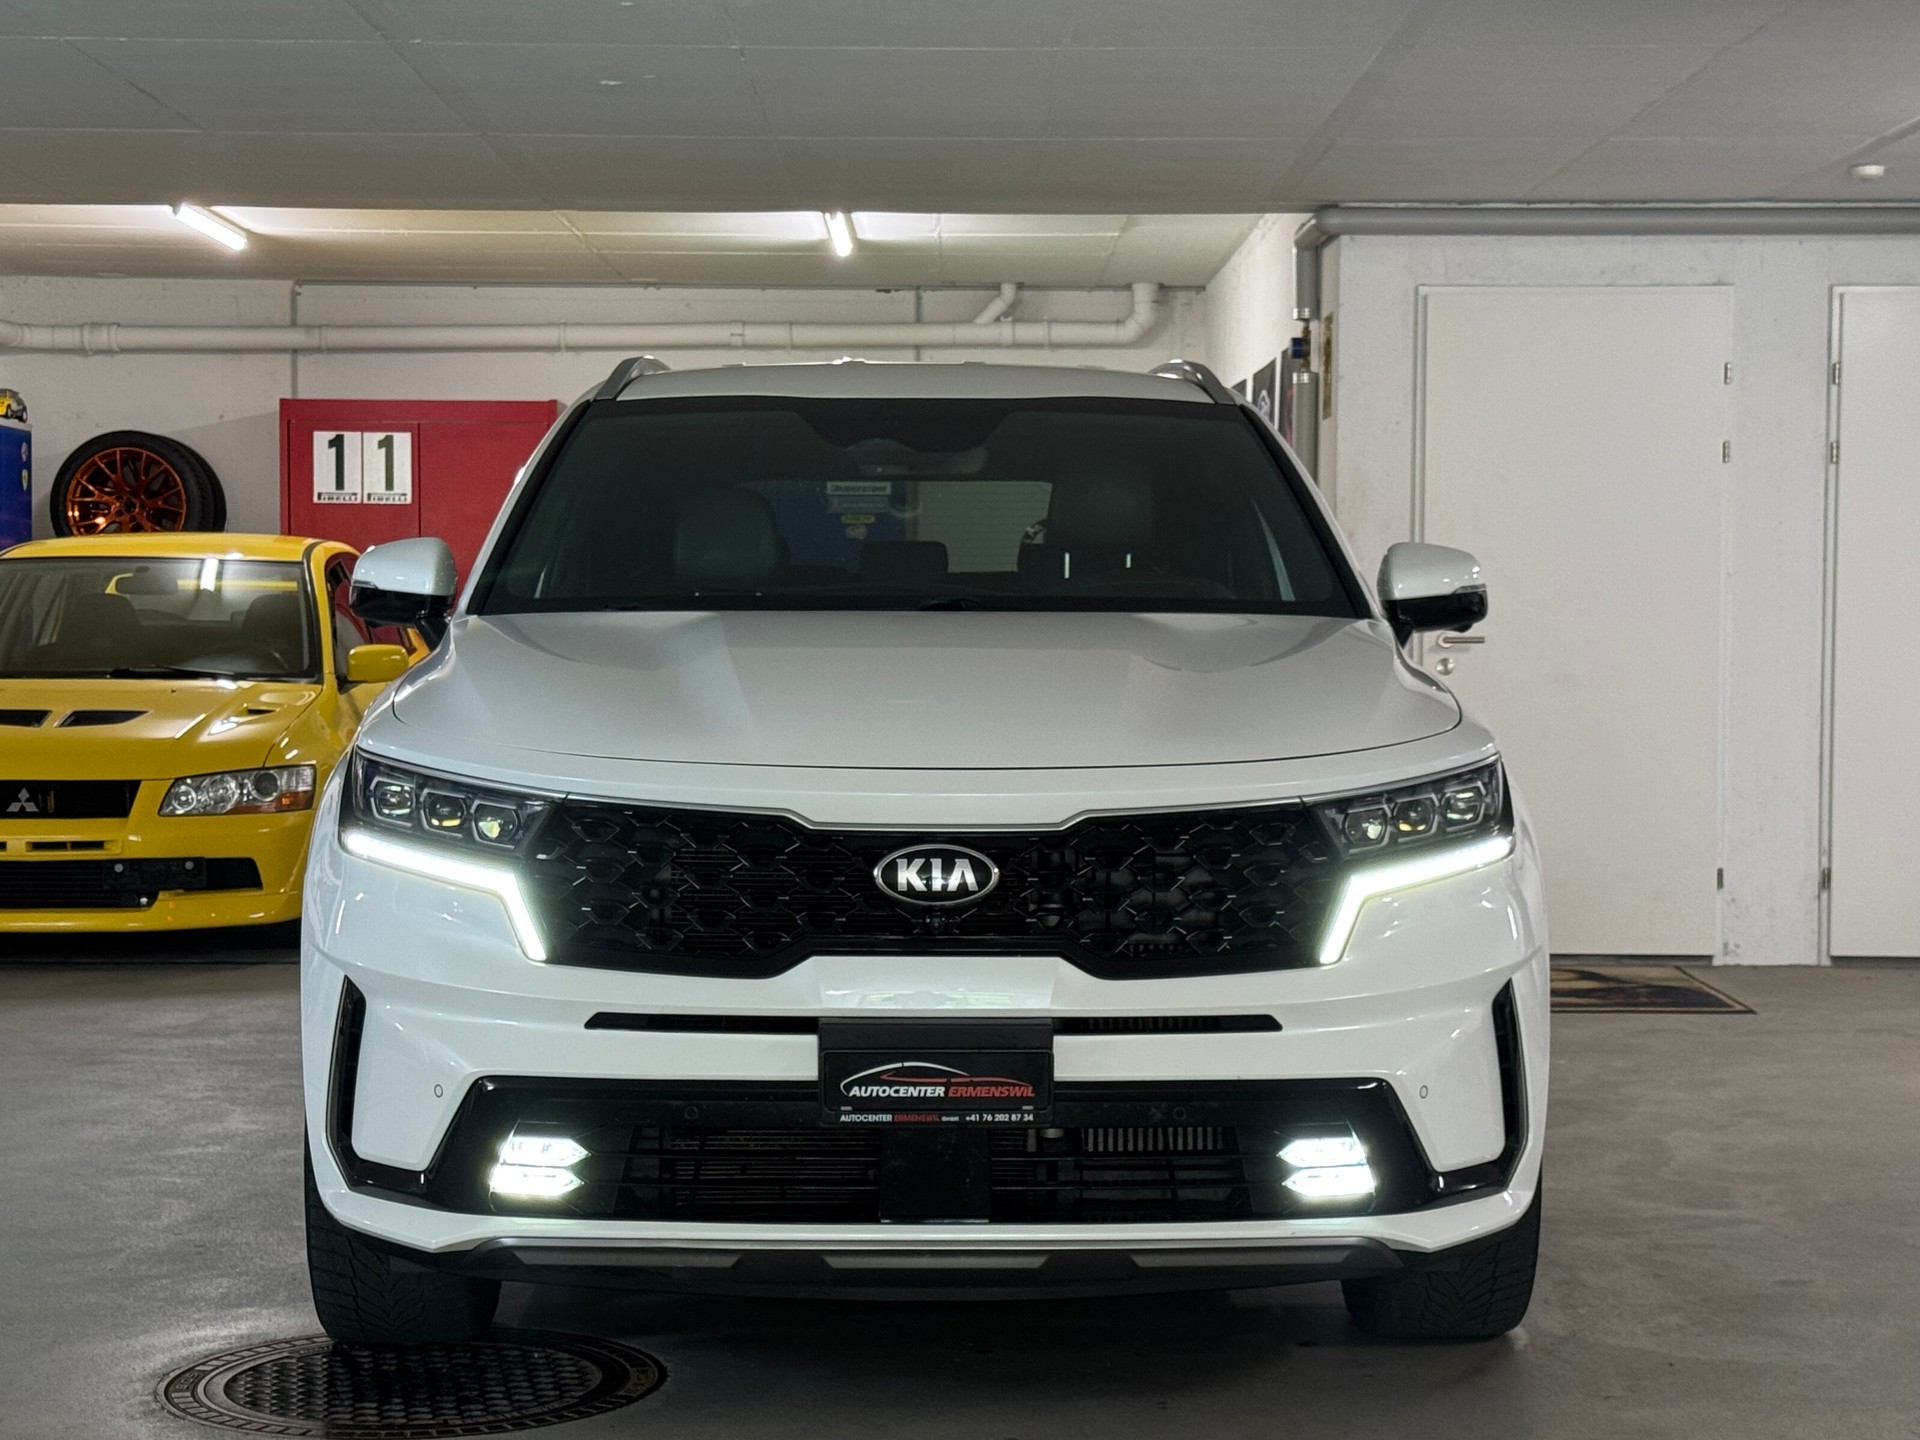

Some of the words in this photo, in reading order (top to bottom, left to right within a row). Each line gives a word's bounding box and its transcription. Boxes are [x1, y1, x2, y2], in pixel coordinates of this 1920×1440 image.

[895, 858, 979, 892] KIA
[848, 1085, 946, 1098] AUTOCENTER
[947, 1085, 1035, 1098] ERMENSWIL
[839, 1113, 893, 1122] AUTOCENTER
[893, 1113, 940, 1122] ERMENSWIL
[965, 1113, 980, 1122] +41
[982, 1113, 993, 1122] 76
[994, 1113, 1009, 1122] 202
[1011, 1113, 1022, 1122] 87
[1023, 1113, 1034, 1122] 34
